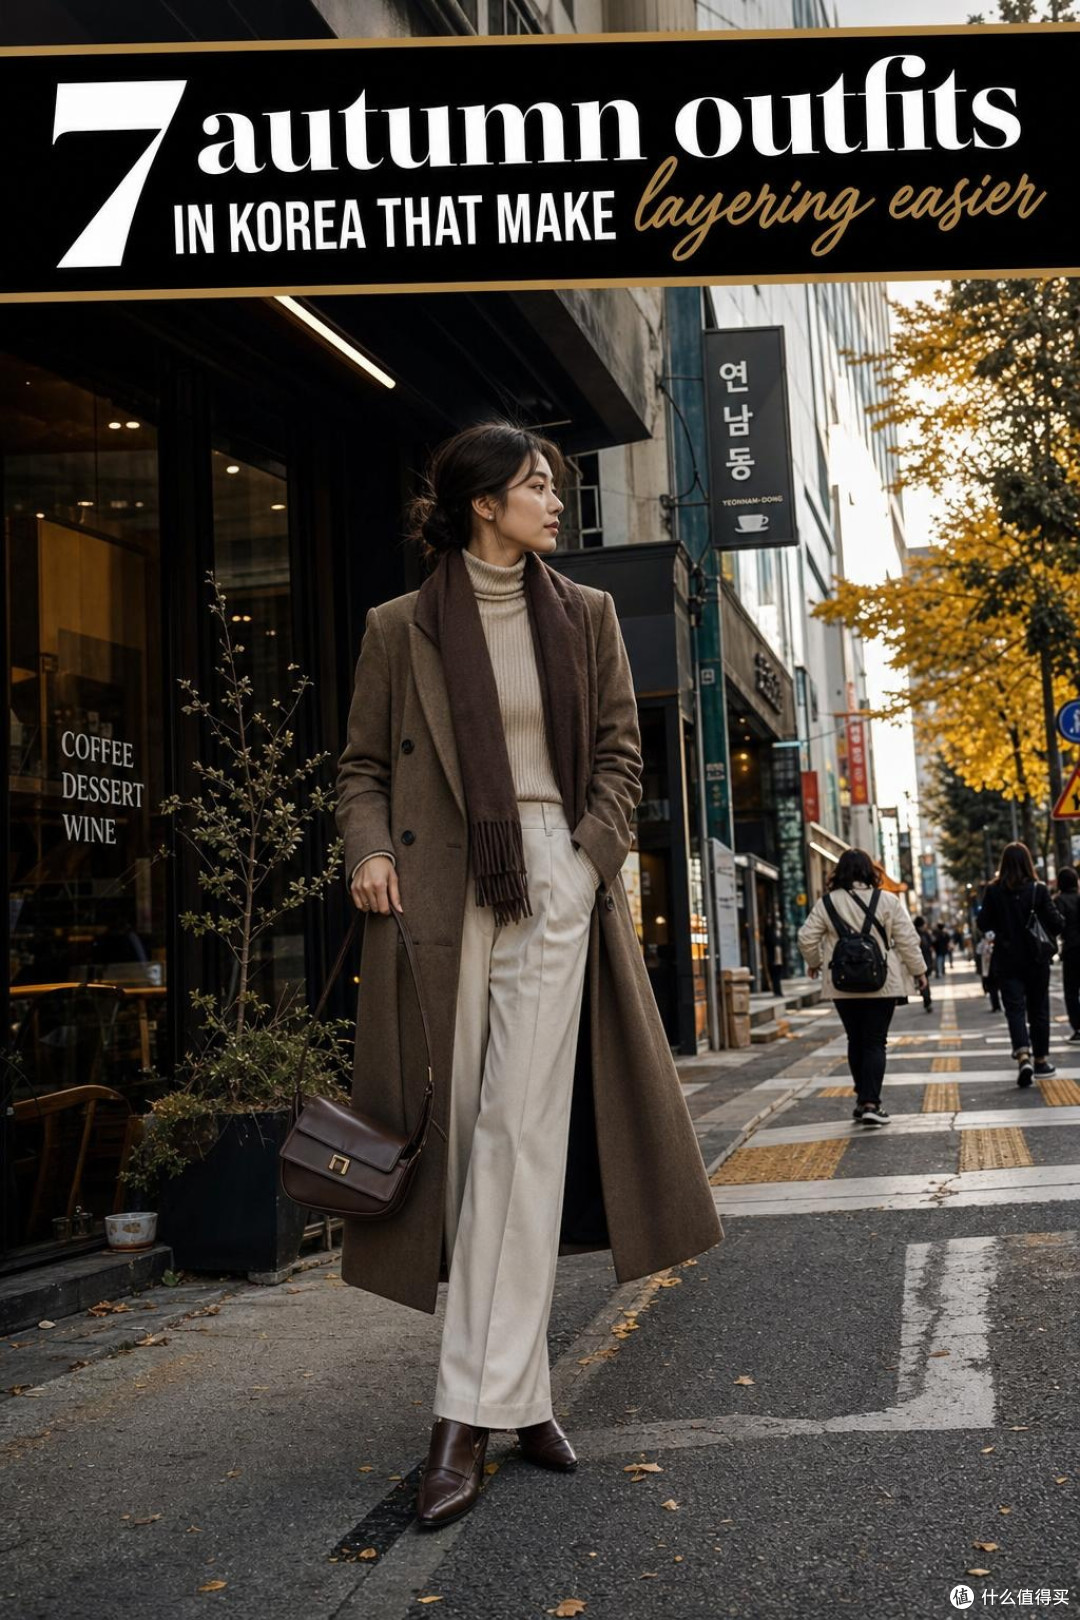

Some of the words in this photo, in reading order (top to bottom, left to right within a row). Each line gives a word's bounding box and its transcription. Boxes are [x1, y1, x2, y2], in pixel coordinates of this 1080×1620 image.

[719, 360, 756, 481] 연남동
[61, 730, 134, 768] COFFEE
[61, 771, 145, 808] DESSERT
[62, 813, 117, 845] WINE
